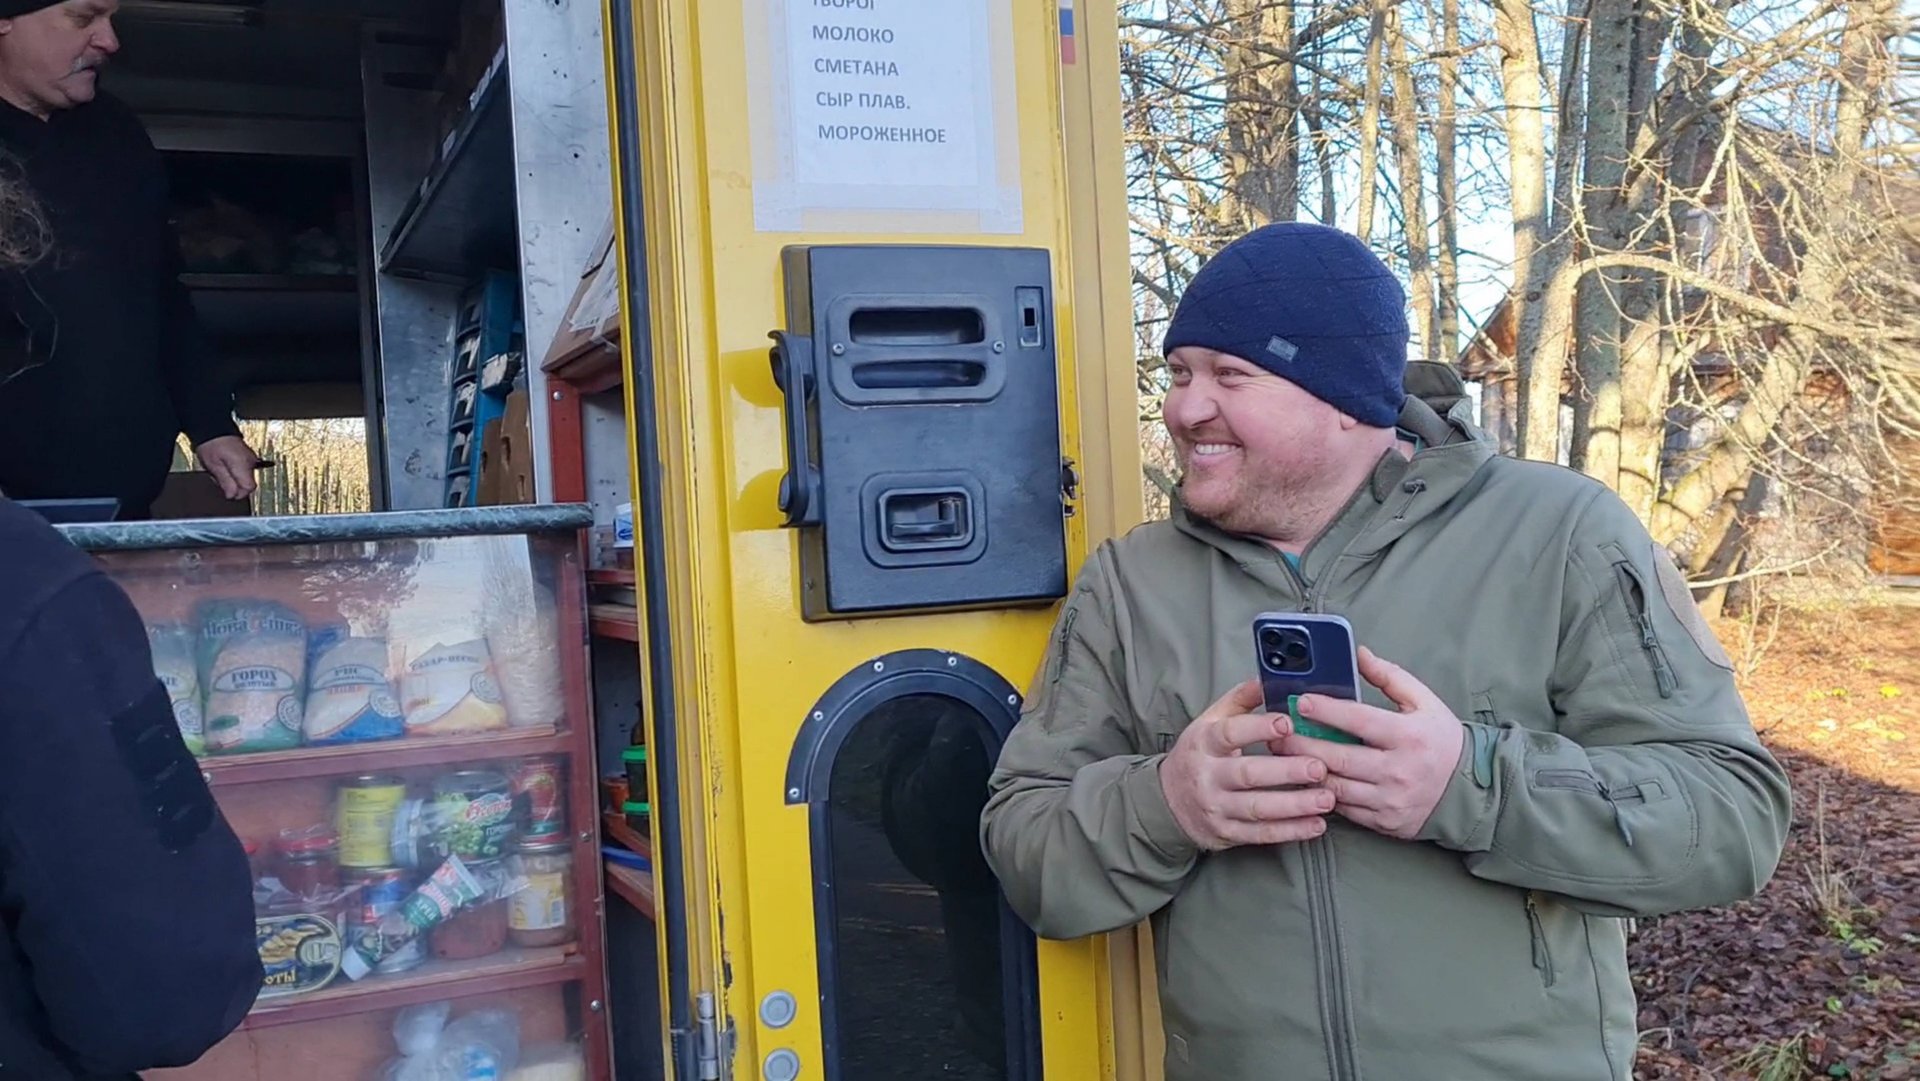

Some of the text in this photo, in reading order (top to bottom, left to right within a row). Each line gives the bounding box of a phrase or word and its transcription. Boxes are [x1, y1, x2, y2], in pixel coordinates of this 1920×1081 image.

[812, 25, 894, 43] МОЛОКО
[814, 58, 899, 76] СМЕТАНА
[816, 91, 911, 110] СЫР ПЛАВ.
[818, 125, 946, 143] МОРОЖЕННОЕ
[232, 669, 278, 684] ГОРОХ
